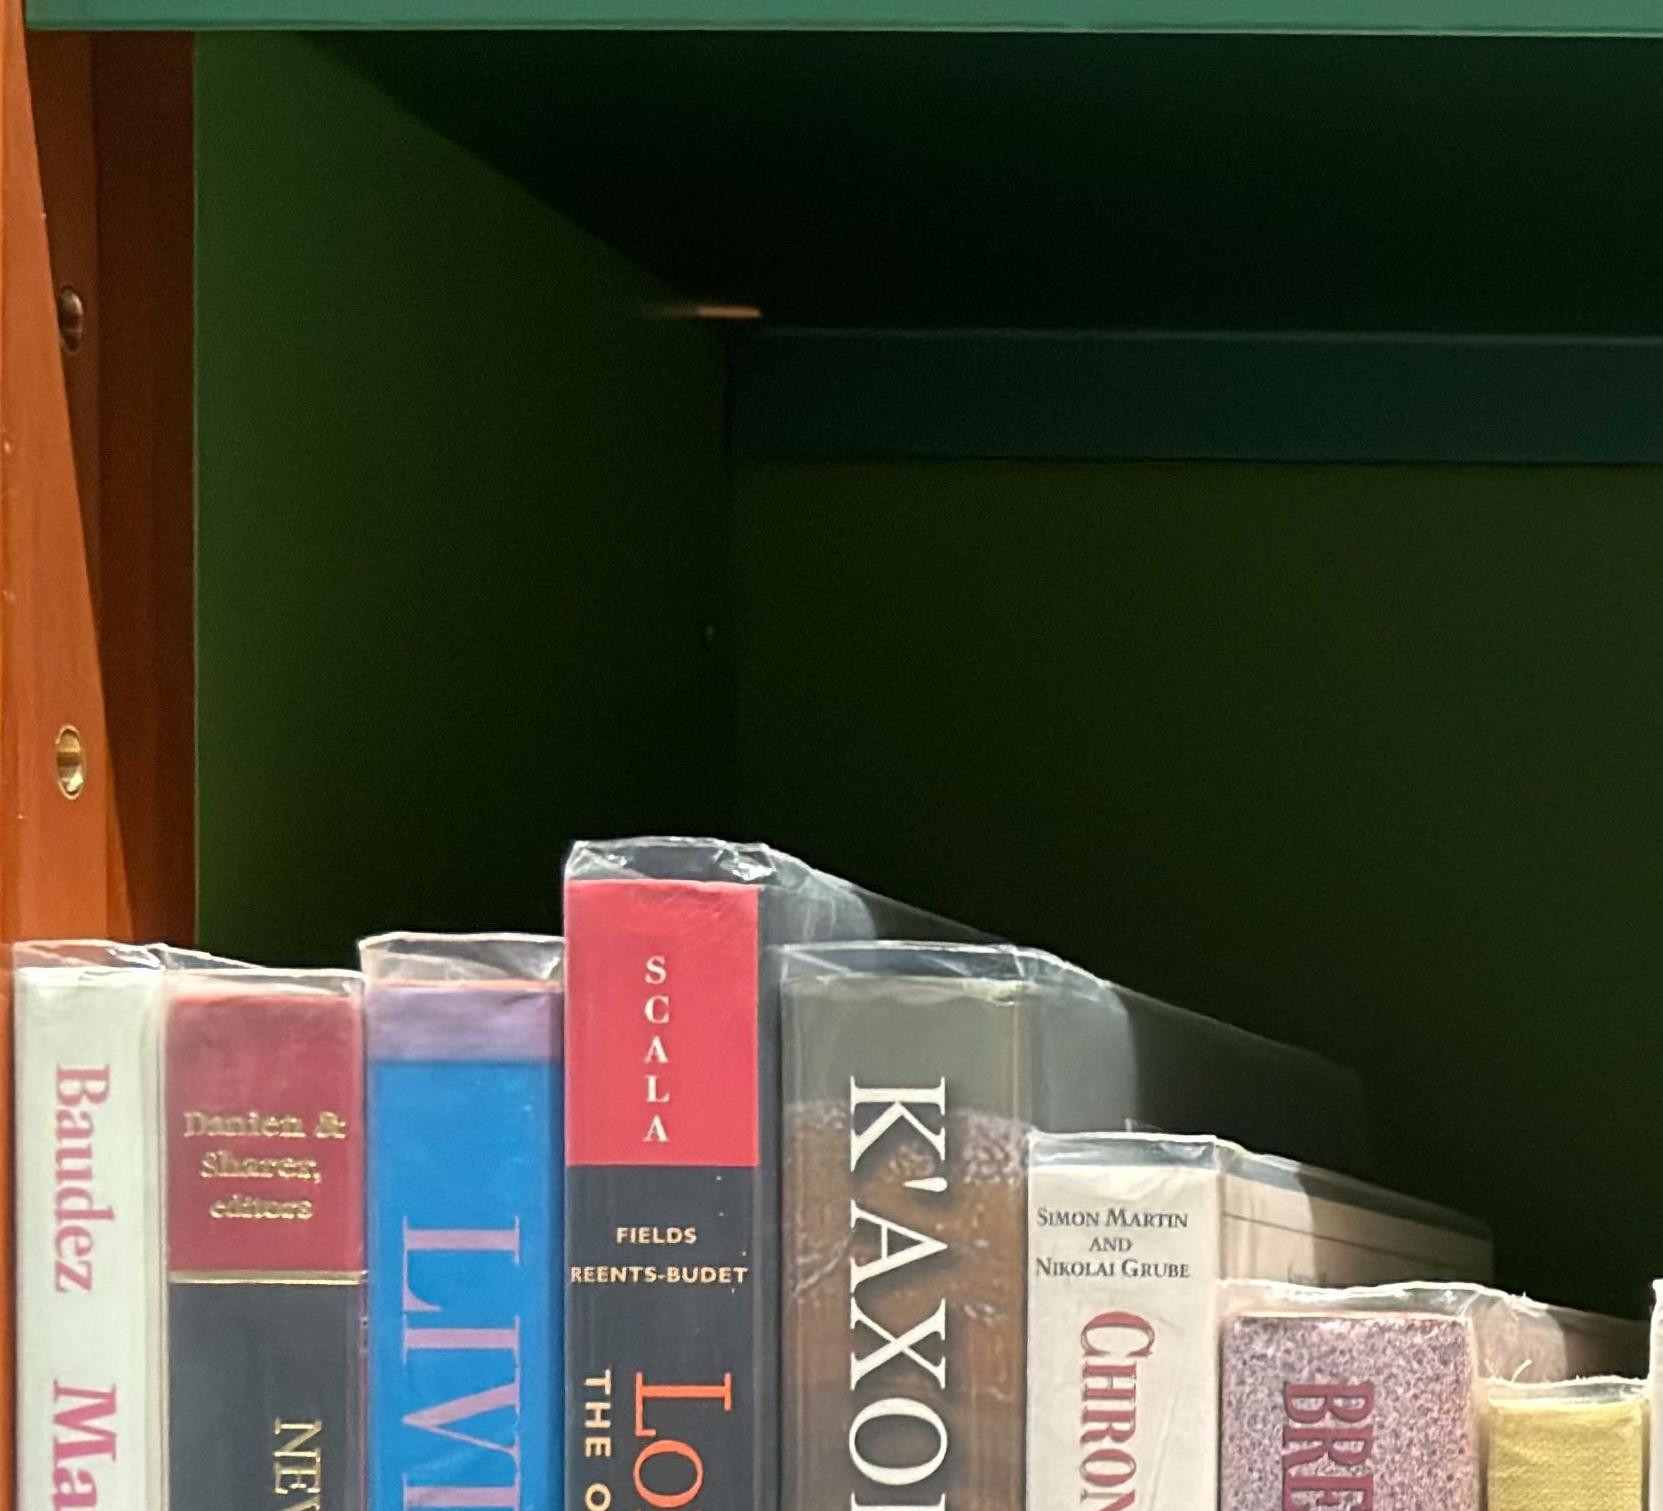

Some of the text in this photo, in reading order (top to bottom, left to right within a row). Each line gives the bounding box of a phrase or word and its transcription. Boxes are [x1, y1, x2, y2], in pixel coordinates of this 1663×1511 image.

[316, 1109, 347, 1140] &
[53, 1064, 115, 1296] Baudez
[200, 1150, 322, 1184] Sharer,
[210, 1195, 312, 1221] editors
[616, 1227, 697, 1245] FIELDS
[1089, 1237, 1132, 1252] AND
[570, 1264, 748, 1285] REENTS-BUDET
[583, 1369, 611, 1458] THE
